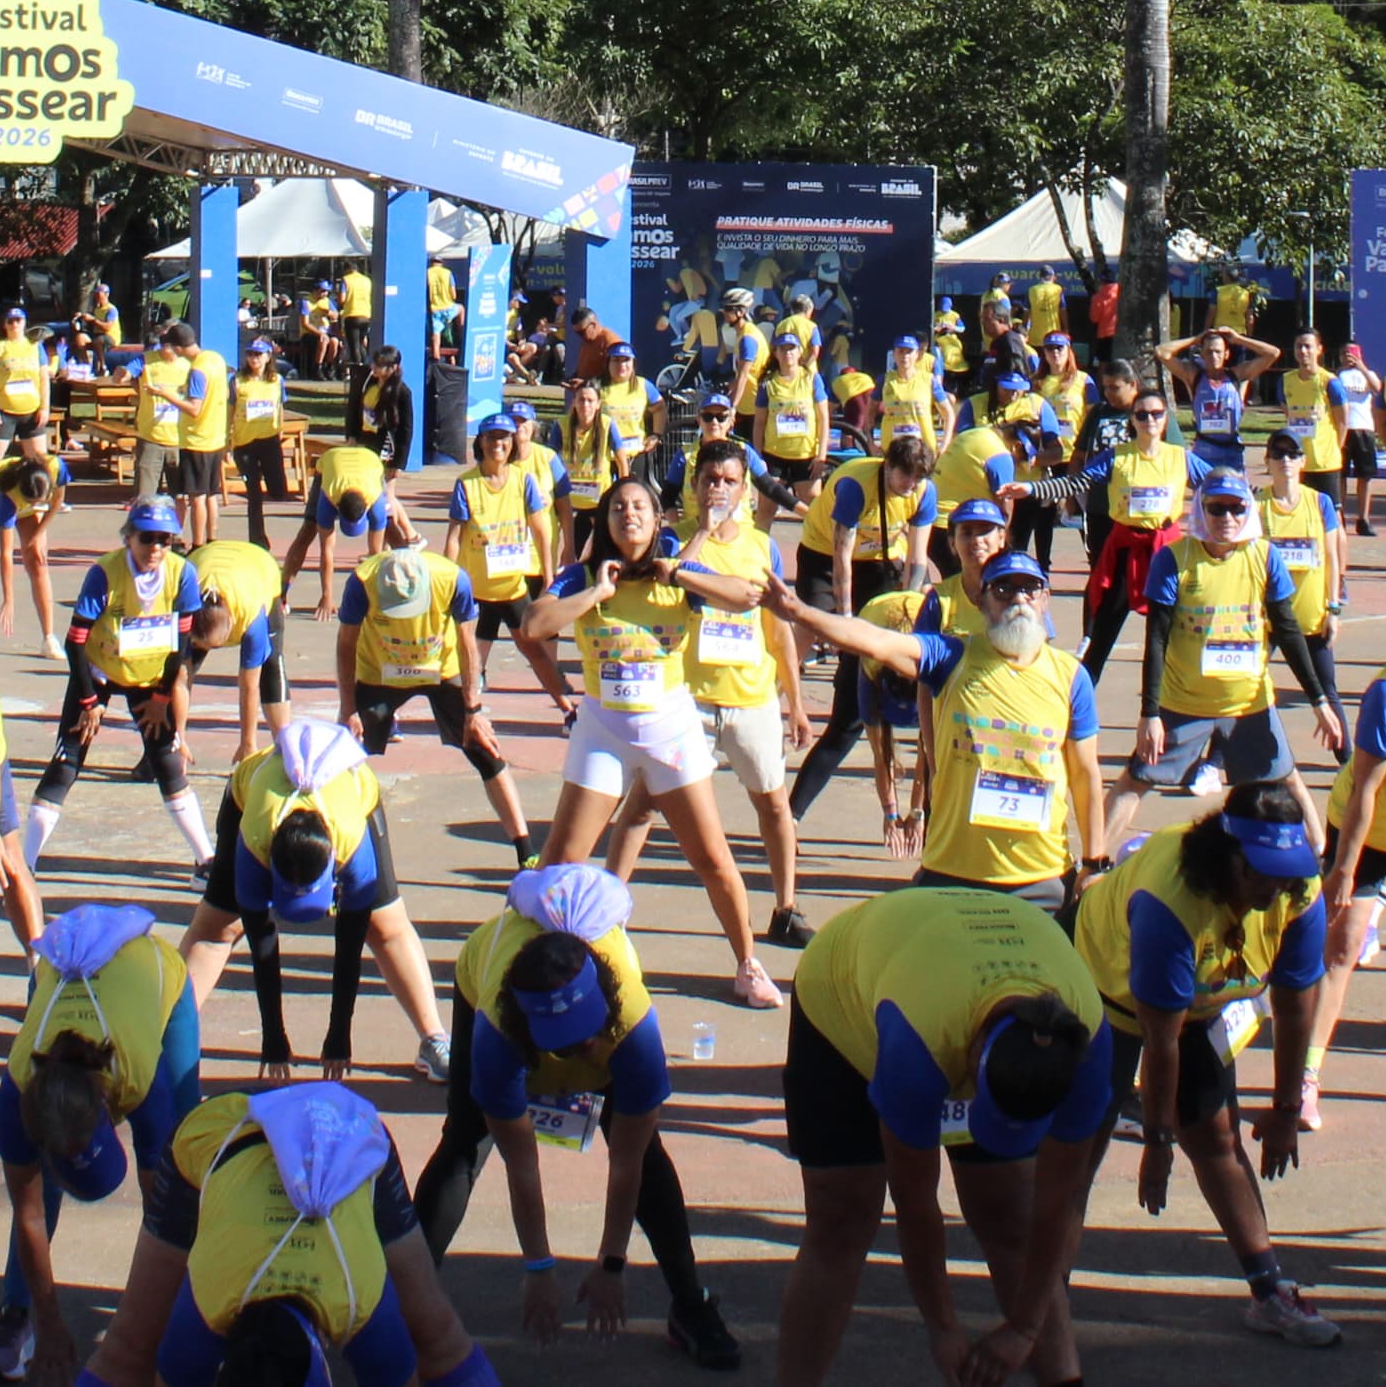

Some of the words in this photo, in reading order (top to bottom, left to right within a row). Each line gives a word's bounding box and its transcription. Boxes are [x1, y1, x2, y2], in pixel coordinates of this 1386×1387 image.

[633, 214, 668, 226] stival
[717, 216, 774, 227] PRATIQUE
[775, 218, 842, 229] ATIVIDADES
[845, 216, 888, 230] FÍSICAS
[633, 229, 674, 245] mos
[723, 234, 753, 242] INVISTA
[762, 235, 778, 243] SEU
[779, 235, 816, 243] DINHEIRO
[817, 236, 839, 244] PARA
[840, 236, 859, 244] MAIS
[631, 245, 680, 259] ssear
[717, 242, 762, 251] QUALIDADE
[763, 243, 774, 251] DE
[775, 243, 796, 251] VIDA
[796, 244, 808, 252] NO
[809, 244, 837, 252] LONGO
[839, 244, 866, 253] PRAZO
[138, 630, 154, 644] 25
[1216, 654, 1242, 665] 400
[613, 684, 640, 697] 563
[999, 795, 1021, 812] 73
